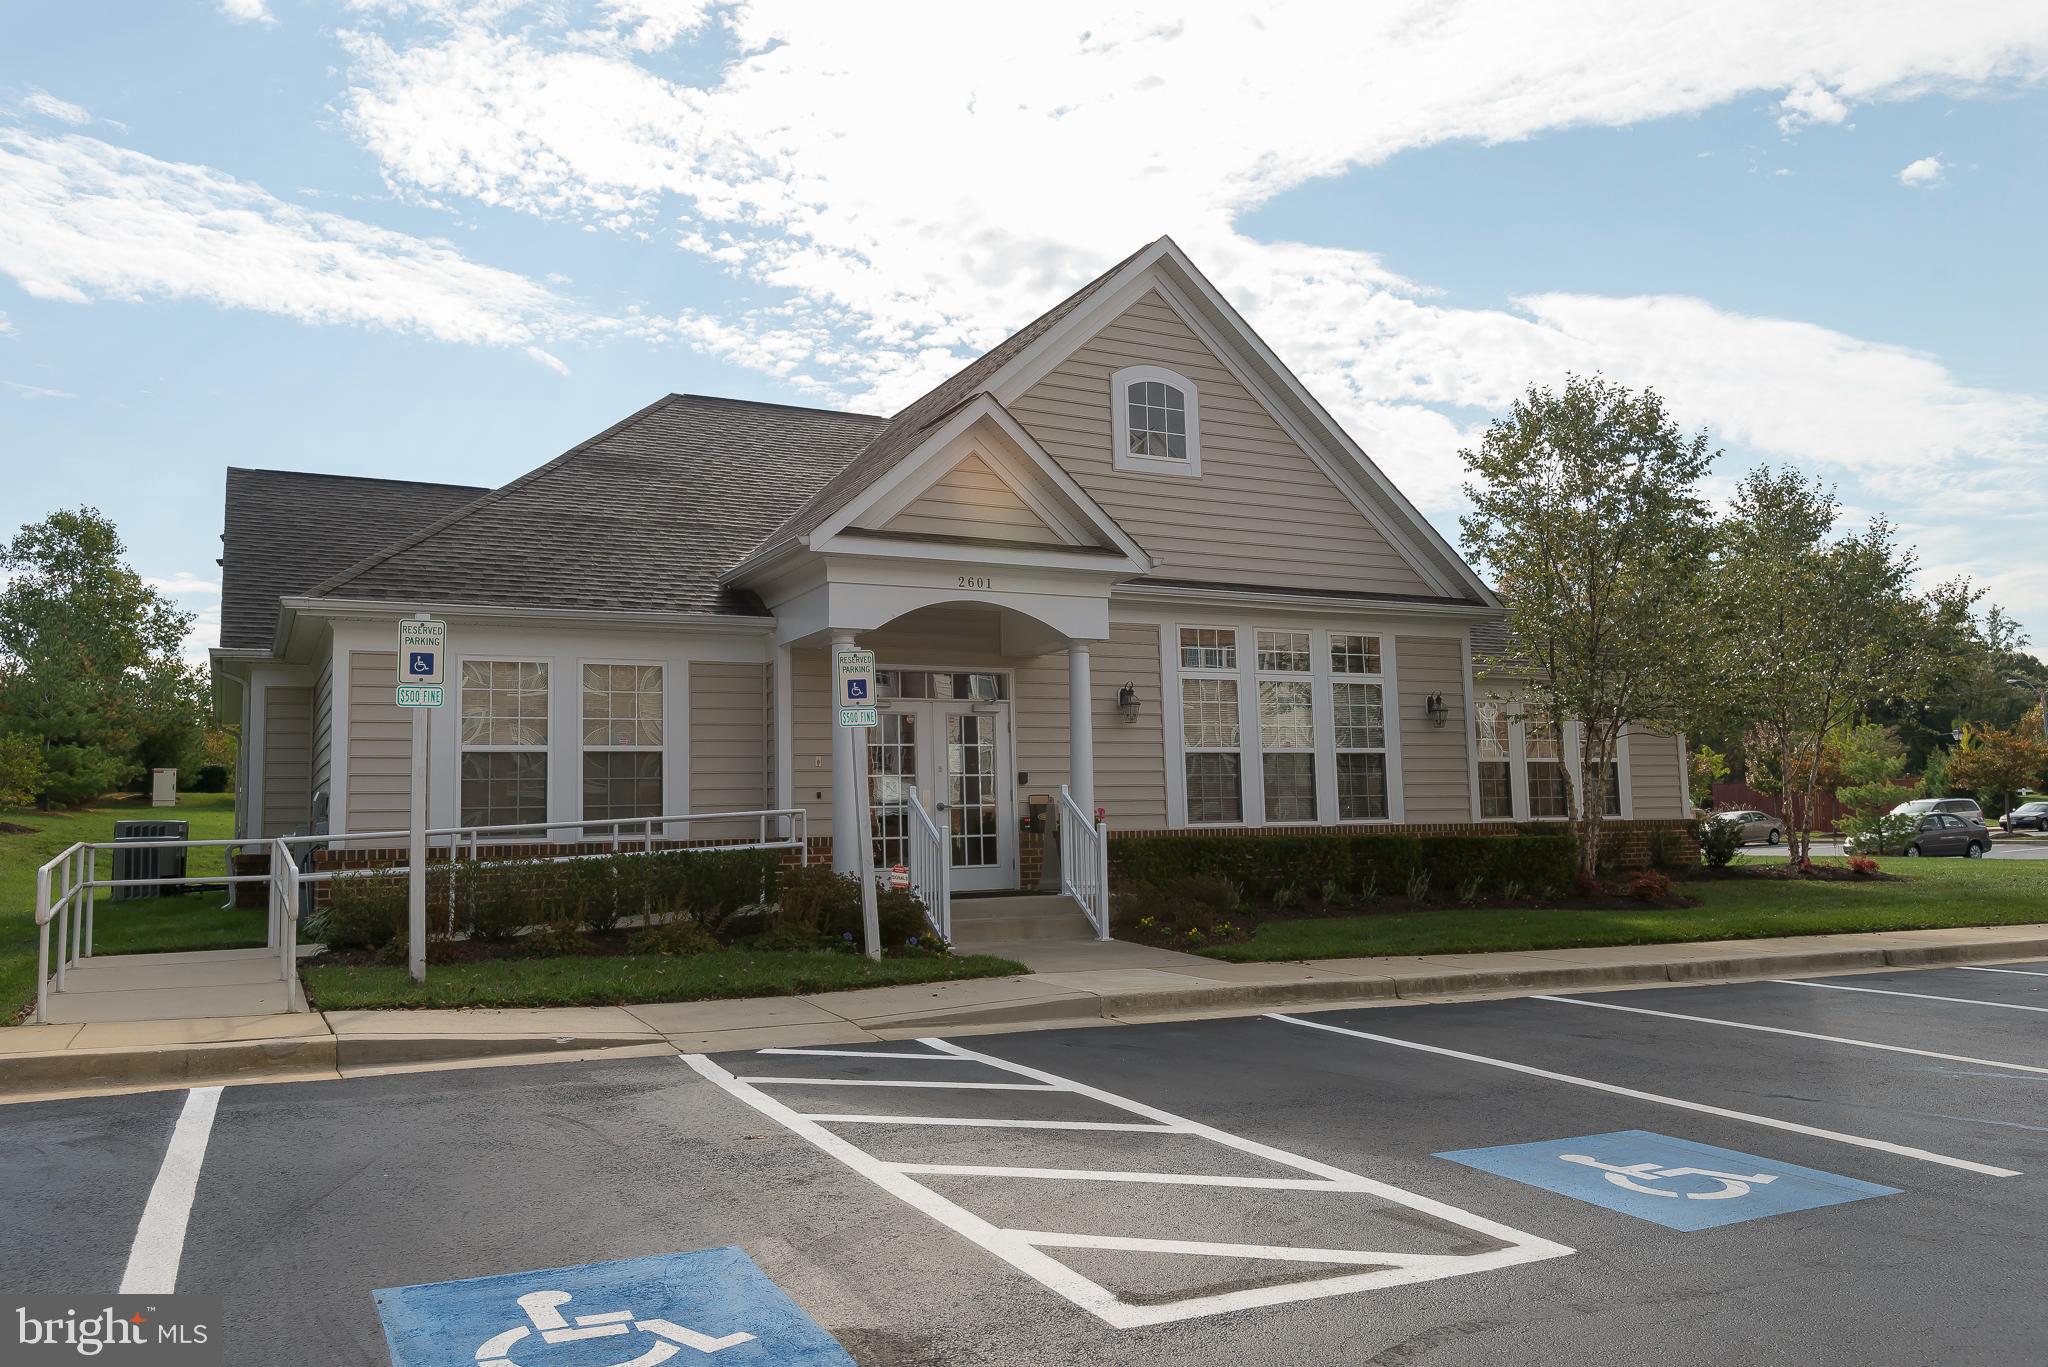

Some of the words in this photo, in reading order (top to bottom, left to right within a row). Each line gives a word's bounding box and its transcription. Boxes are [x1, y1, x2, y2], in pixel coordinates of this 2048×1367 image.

[958, 576, 991, 589] 2601
[402, 625, 443, 635] RESERVED
[405, 636, 440, 646] PARKING
[840, 656, 872, 664] RESERVED
[843, 665, 870, 673] PARKING
[400, 689, 420, 703] $500
[423, 690, 441, 703] FINE
[842, 712, 859, 724] $500
[860, 711, 875, 723] FINE
